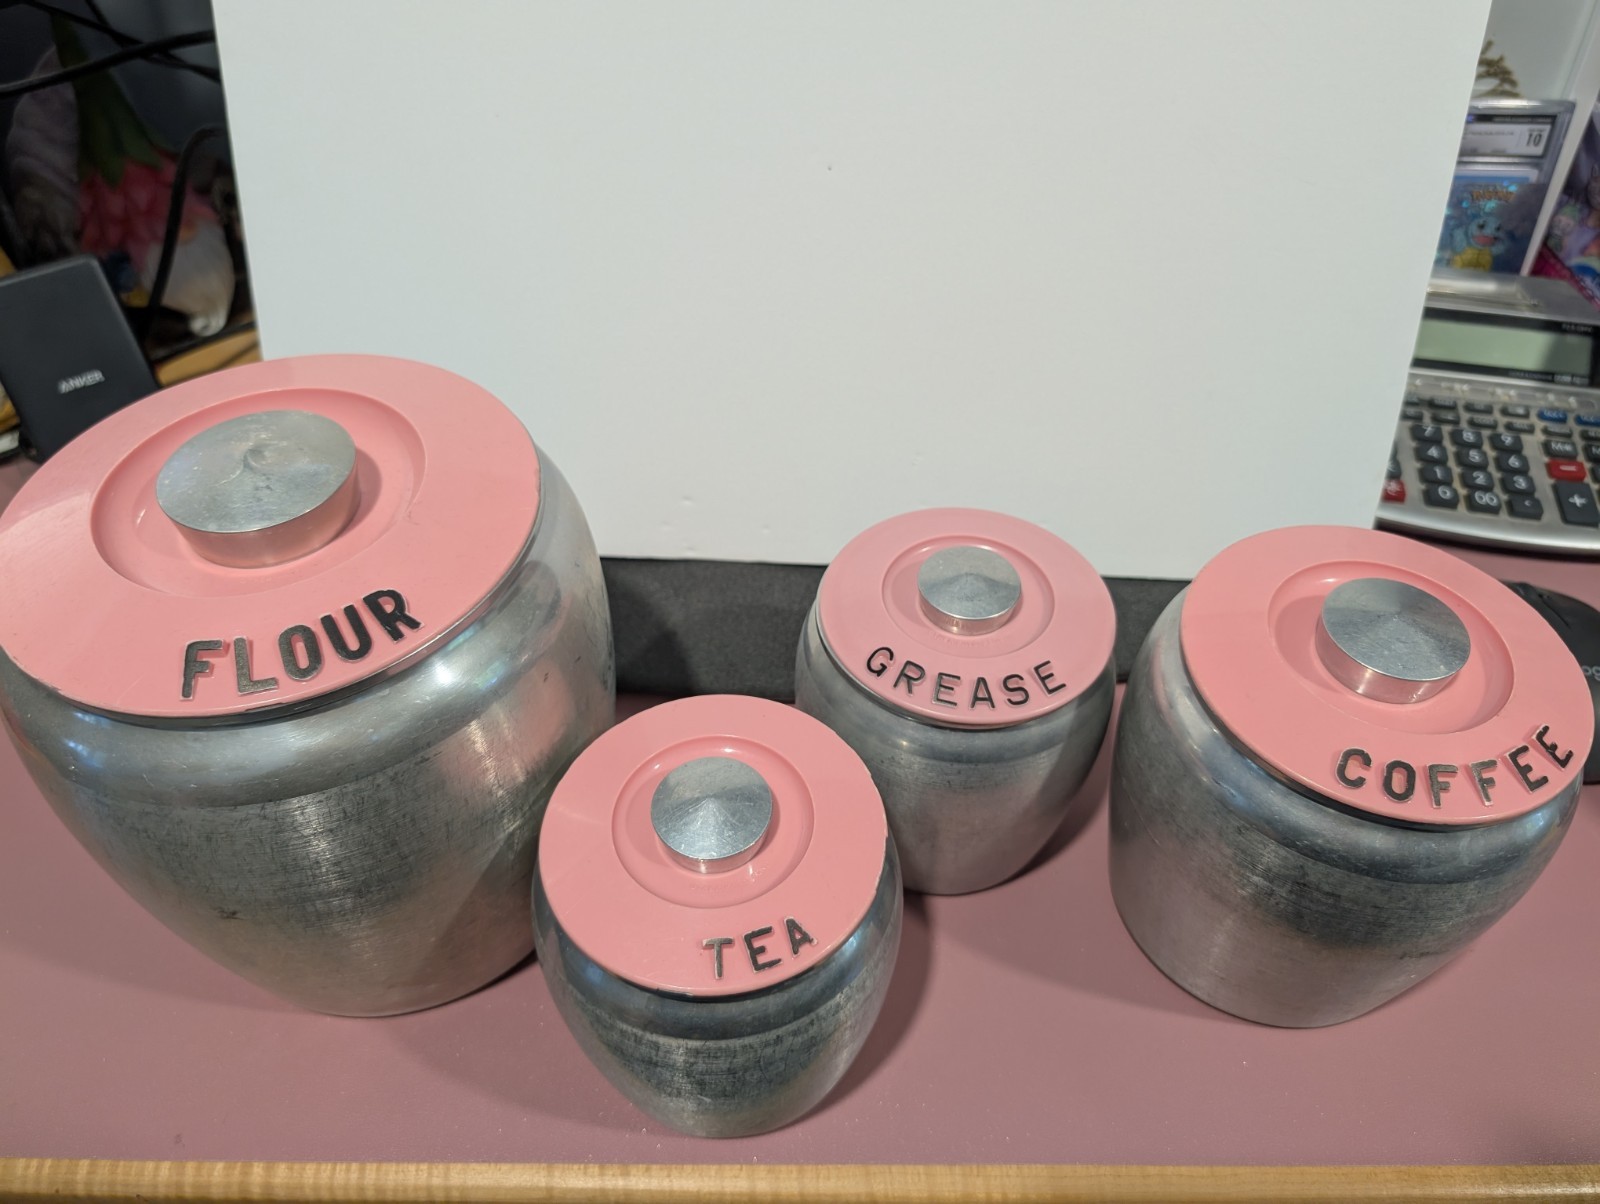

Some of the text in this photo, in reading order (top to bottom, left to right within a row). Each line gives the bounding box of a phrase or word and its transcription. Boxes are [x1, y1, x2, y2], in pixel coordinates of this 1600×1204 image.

[1525, 133, 1543, 147] 10
[58, 369, 105, 394] ANKER
[1421, 424, 1435, 437] 7
[1426, 445, 1521, 468] 4 5 6
[1433, 465, 1528, 489] 1 2 3
[1438, 484, 1454, 500] 0
[179, 588, 424, 700] FLOUR
[866, 646, 1067, 709] GREASE
[1335, 724, 1574, 809] COFFEE
[702, 916, 818, 980] TEA
